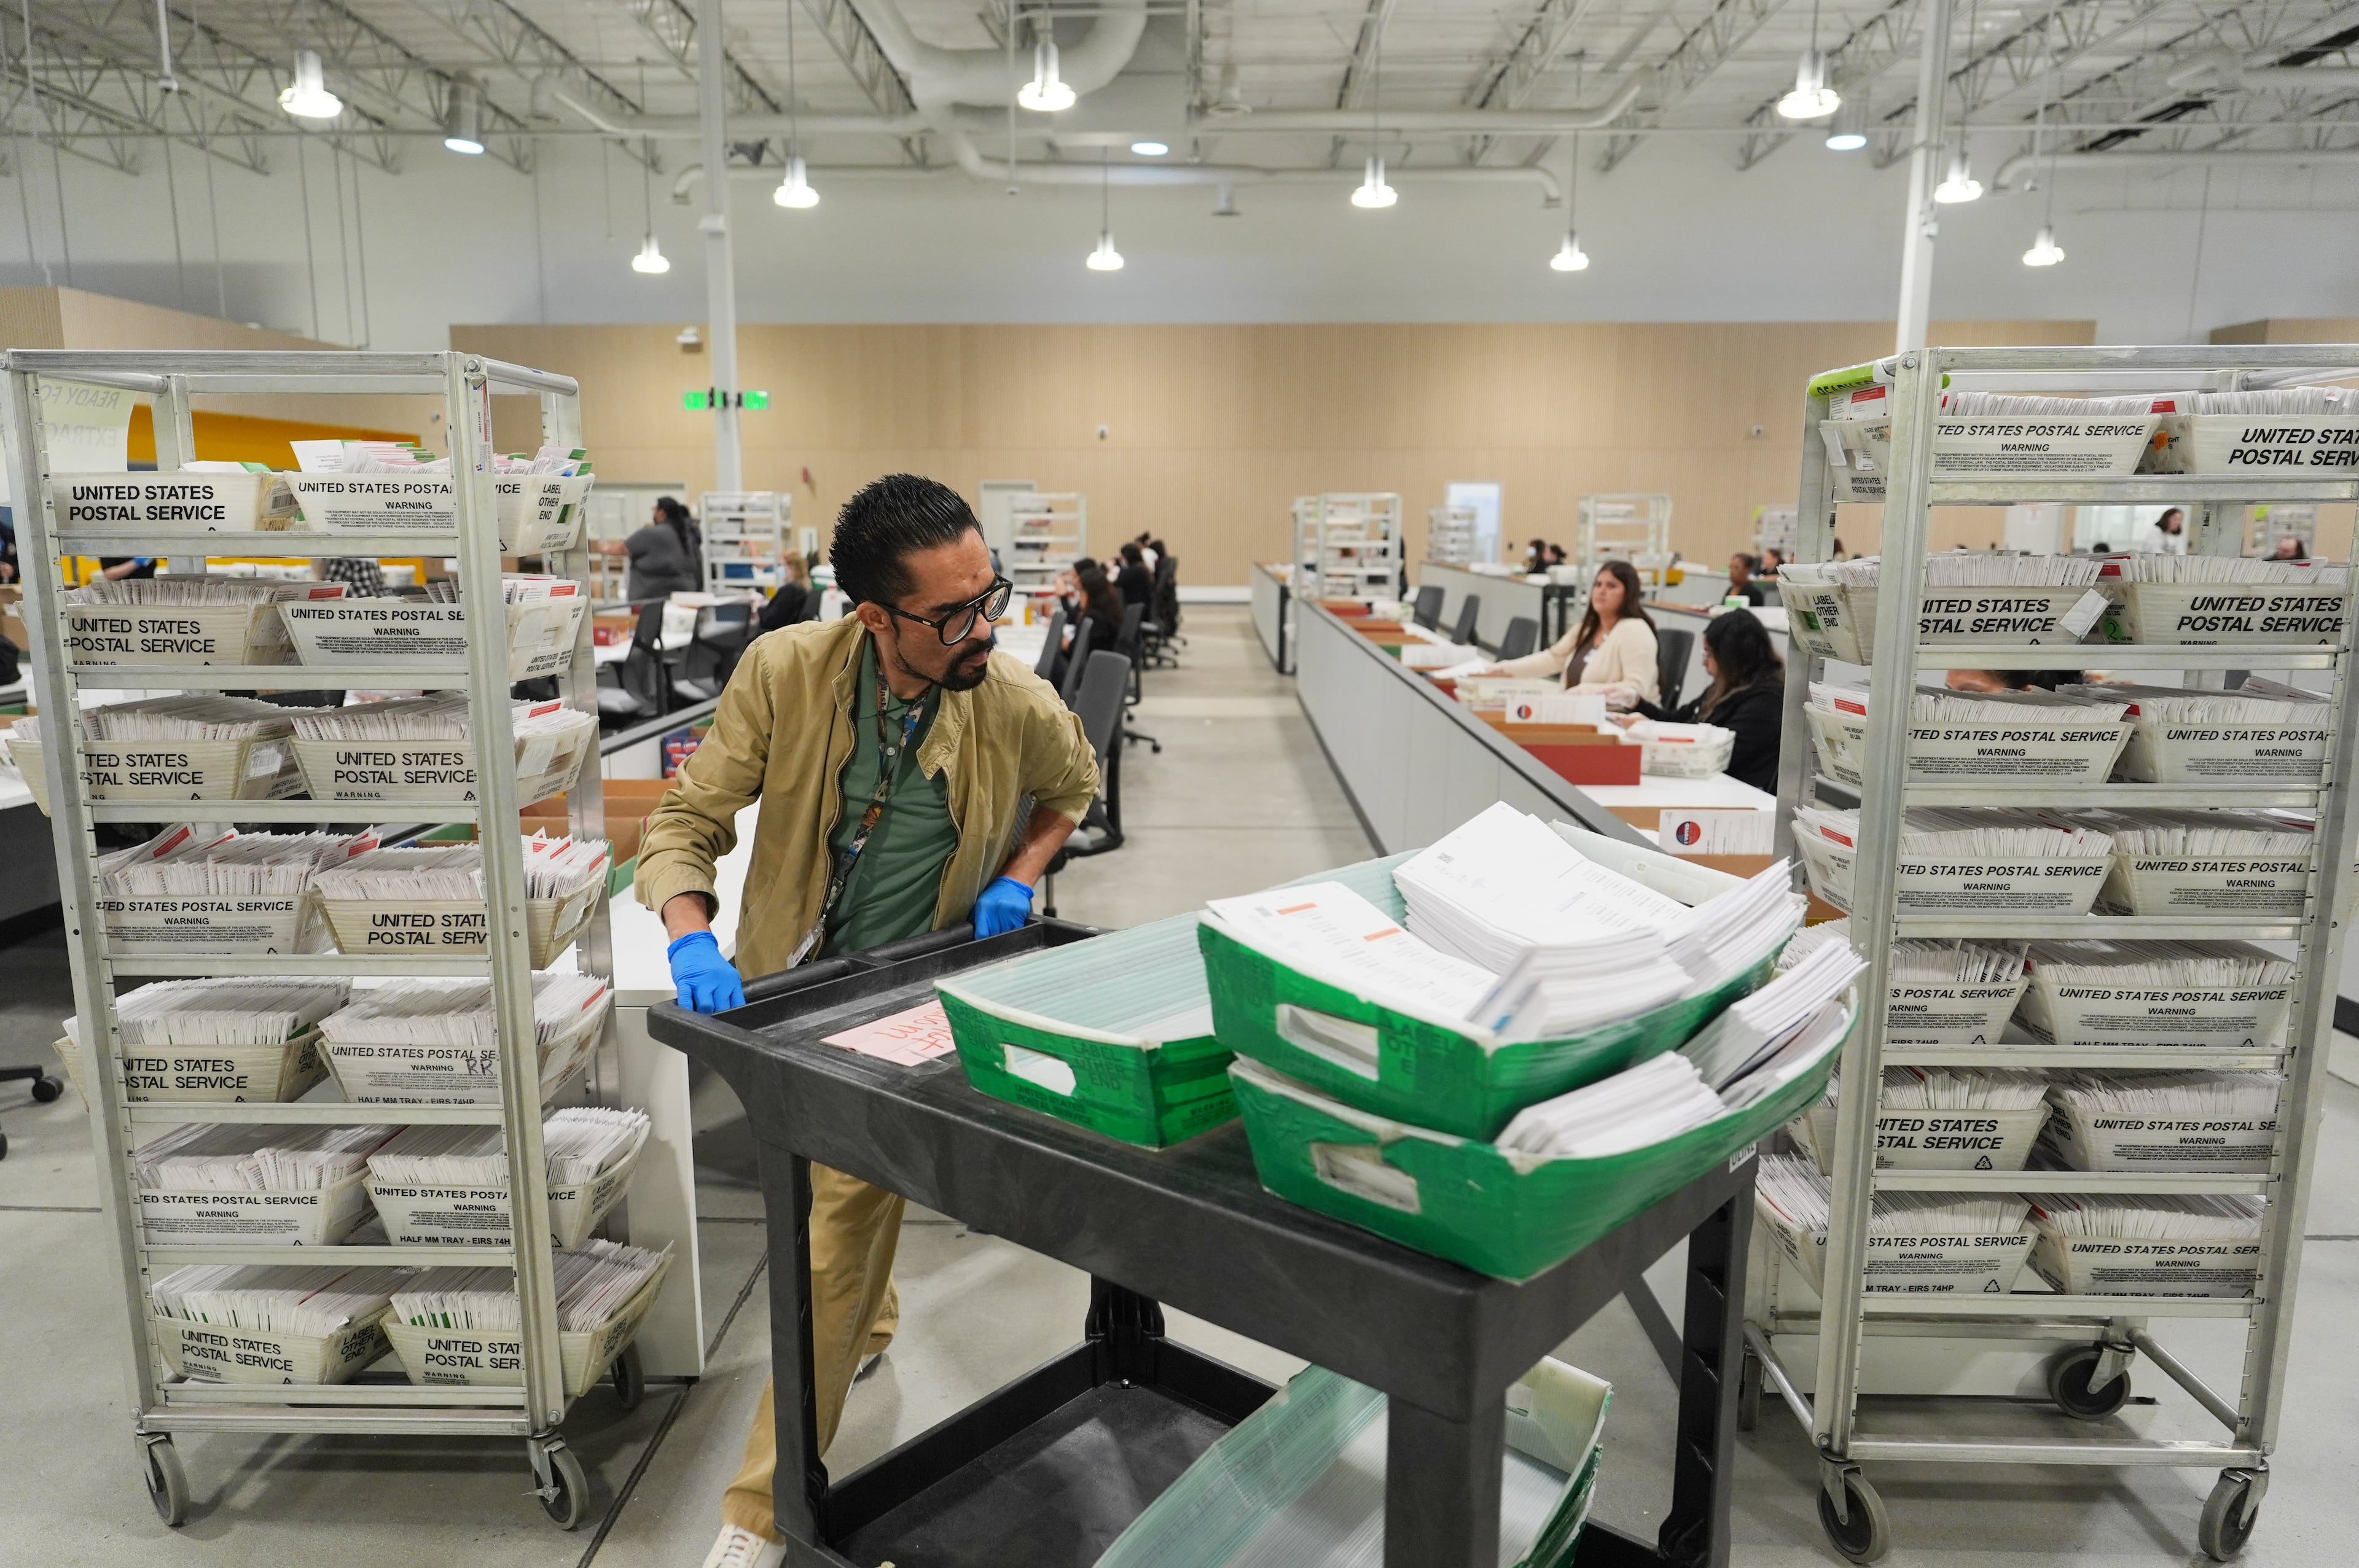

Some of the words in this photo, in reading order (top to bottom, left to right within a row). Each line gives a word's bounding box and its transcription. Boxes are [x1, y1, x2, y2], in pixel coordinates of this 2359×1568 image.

[1968, 425, 2022, 437] STATES
[2025, 425, 2081, 437] POSTAL
[2084, 424, 2145, 436] SERVICE
[2241, 428, 2315, 444] UNITED
[2001, 443, 2050, 452] WARNING
[2228, 449, 2304, 465] POSTAL
[72, 486, 140, 501] UNITED
[144, 485, 214, 500] STATES
[298, 482, 345, 493] UNITED
[348, 483, 400, 494] STATES
[404, 483, 452, 494] POSTA
[542, 484, 561, 494] LABEL
[385, 501, 433, 510] WARNING
[538, 496, 560, 507] OTHER
[69, 505, 141, 521] POSTAL
[146, 505, 225, 520] SERVICE
[538, 510, 553, 520] END
[1812, 595, 1836, 605] LABEL
[1976, 599, 2051, 613] STATES
[2190, 596, 2266, 612] UNITED
[2267, 597, 2343, 612] STATES
[291, 608, 335, 620] UNITED
[337, 609, 388, 621] STATES
[391, 610, 444, 622] POSTAL
[1816, 606, 1840, 616] OTHER
[71, 618, 132, 634] UNITED
[138, 620, 201, 634] STATES
[1823, 617, 1839, 627] END
[1970, 617, 2057, 633] SERVICE
[2177, 616, 2255, 632] POSTAL
[2259, 617, 2344, 633] SERVICE
[373, 627, 420, 636] WARNING
[70, 637, 135, 653] POSTAL
[140, 638, 216, 653] SERVICE
[1943, 730, 1998, 741] STATES
[2001, 731, 2056, 741] POSTAL
[2060, 730, 2120, 741] SERVICE
[2166, 730, 2219, 741] UNITED
[2221, 730, 2275, 741] STATES
[2278, 731, 2328, 741] POSTA
[336, 752, 396, 766] UNITED
[401, 752, 464, 766] STATES
[1977, 748, 2026, 757] WARNING
[2255, 749, 2303, 757] WARNING
[85, 754, 120, 768] TED
[125, 754, 189, 768] STATES
[128, 771, 204, 786] SERVICE
[334, 770, 399, 784] POSTAL
[1930, 866, 1983, 876] STATES
[1986, 867, 2041, 876] POSTAL
[2044, 866, 2103, 876] SERVICE
[2135, 860, 2188, 872] UNITED
[2191, 861, 2246, 872] STATES
[2249, 862, 2305, 873] POSTAL
[1963, 883, 2011, 891] WARNING
[2226, 879, 2276, 888] WARNING
[128, 902, 178, 912] STATES
[182, 902, 234, 912] POSTAL
[237, 901, 294, 912] SERVICE
[164, 917, 209, 926] WARNING
[372, 914, 435, 928] UNITED
[368, 932, 432, 945] POSTAL
[441, 931, 487, 945] SERV
[1904, 989, 1957, 999] POSTAL
[1960, 988, 2016, 998] SERVICE
[2059, 988, 2111, 1000] UNITED
[2114, 991, 2169, 1002] STATES
[2172, 991, 2226, 1002] POSTAL
[2229, 989, 2287, 1001] SERVICE
[2148, 1007, 2196, 1016] WARNING
[332, 1046, 374, 1058] UNITED
[378, 1048, 424, 1059] STATES
[428, 1049, 477, 1059] POSTAL
[173, 1059, 235, 1072] STATES
[175, 1075, 249, 1089] SERVICE
[1928, 1119, 1999, 1133] STATES
[2094, 1118, 2144, 1131] UNITED
[2146, 1121, 2199, 1131] STATES
[2202, 1122, 2255, 1132] POSTAL
[1922, 1136, 2005, 1150] SERVICE
[374, 1187, 418, 1198] UNITED
[421, 1188, 467, 1199] STATES
[163, 1195, 209, 1205] STATES
[213, 1196, 262, 1205] POSTAL
[265, 1195, 318, 1205] SERVICE
[196, 1210, 239, 1219] WARNING
[399, 1235, 423, 1244] HALF
[424, 1236, 439, 1244] MM
[1868, 1238, 1917, 1247] STATES
[1920, 1237, 1970, 1247] POSTAL
[1974, 1236, 2028, 1247] SERVICE
[2071, 1244, 2121, 1254] UNITED
[2124, 1245, 2175, 1255] STATES
[2178, 1246, 2229, 1255] POSTAL
[343, 1324, 376, 1346] LABEL
[181, 1329, 229, 1348] UNITED
[232, 1338, 281, 1355] STATES
[340, 1332, 375, 1355] OTHER
[427, 1338, 483, 1353] UNITED
[487, 1342, 520, 1355] STAT
[182, 1343, 232, 1363] POSTAL
[235, 1353, 294, 1371] SERVICE
[344, 1346, 366, 1363] END
[425, 1353, 484, 1369] POSTAL
[182, 1360, 217, 1371] WARNING
[423, 1370, 466, 1379] WARNING
